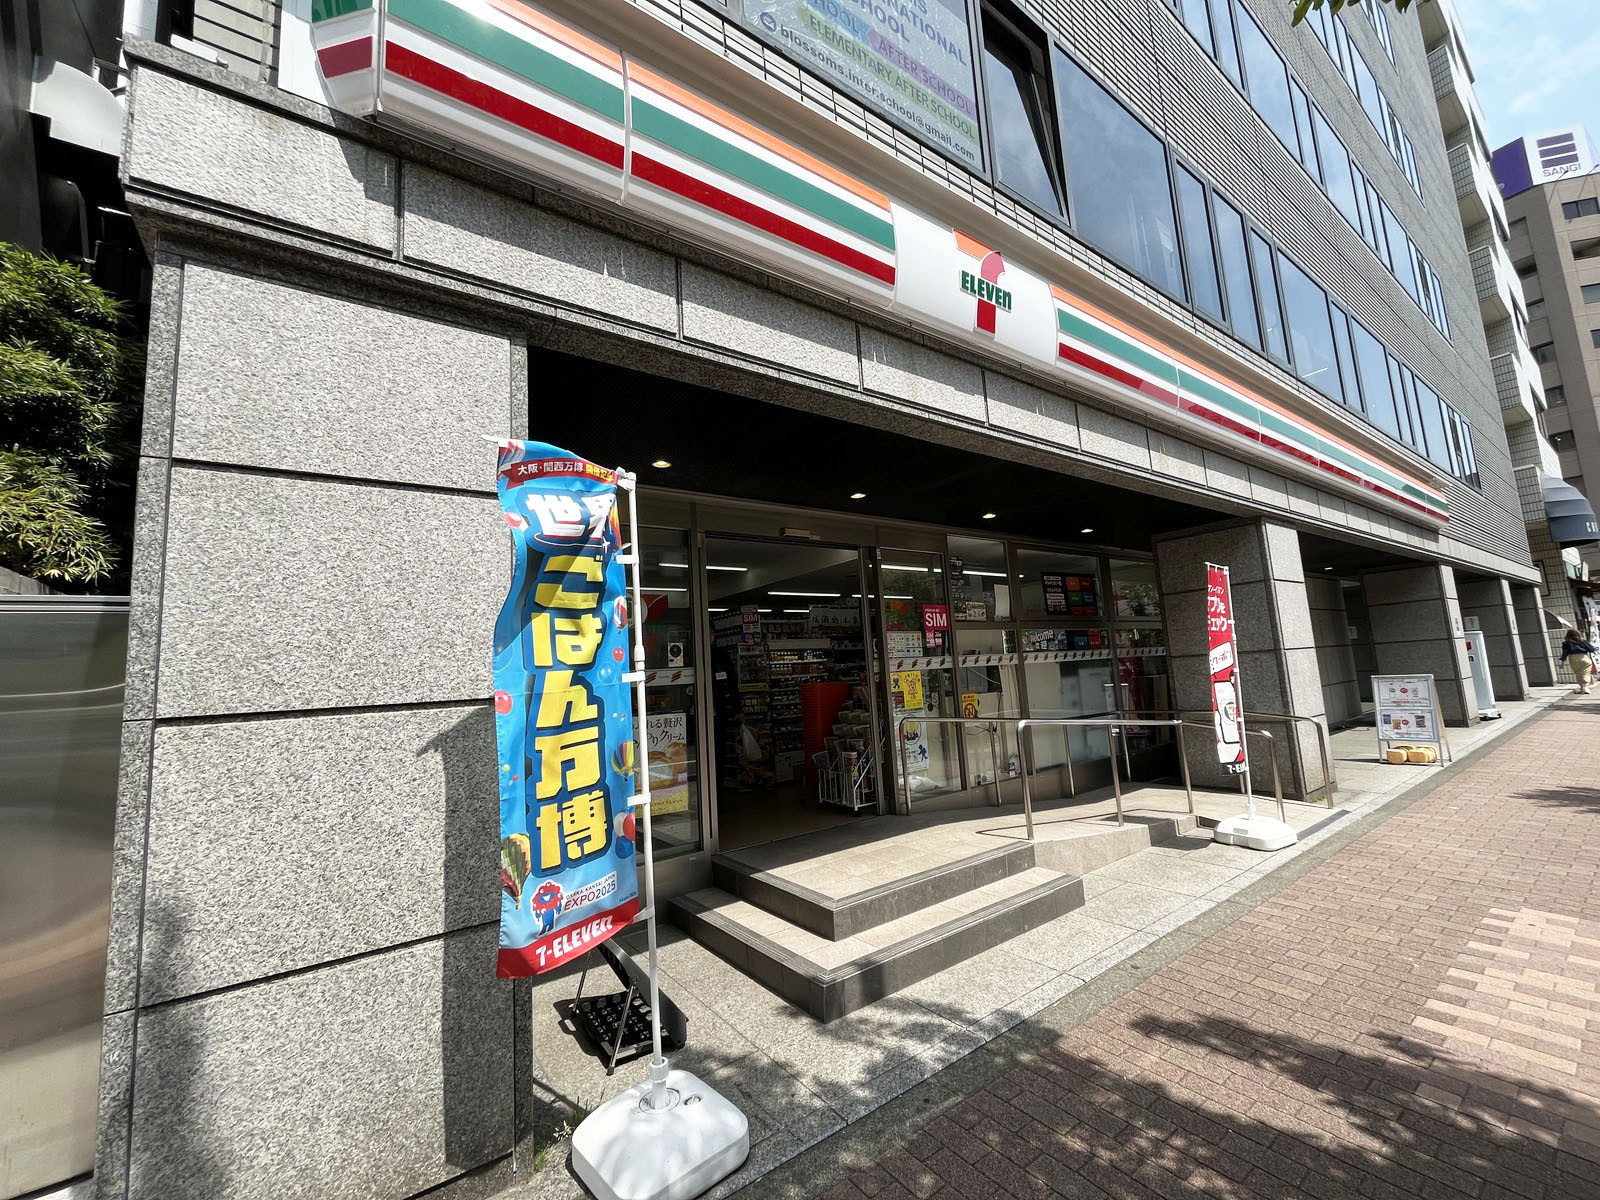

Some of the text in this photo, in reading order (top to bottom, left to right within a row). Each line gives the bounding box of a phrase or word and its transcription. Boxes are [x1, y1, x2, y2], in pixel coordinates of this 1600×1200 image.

[853, 0, 911, 43] HOOL
[882, 0, 967, 66] NATIONAL
[809, 14, 976, 139] ELEMENTARY AFTER SCHOOL
[878, 39, 973, 114] AFTER SCHOOL
[925, 612, 948, 627] SIM
[534, 554, 608, 870] ごはん万博
[564, 879, 616, 911] EXPO2025
